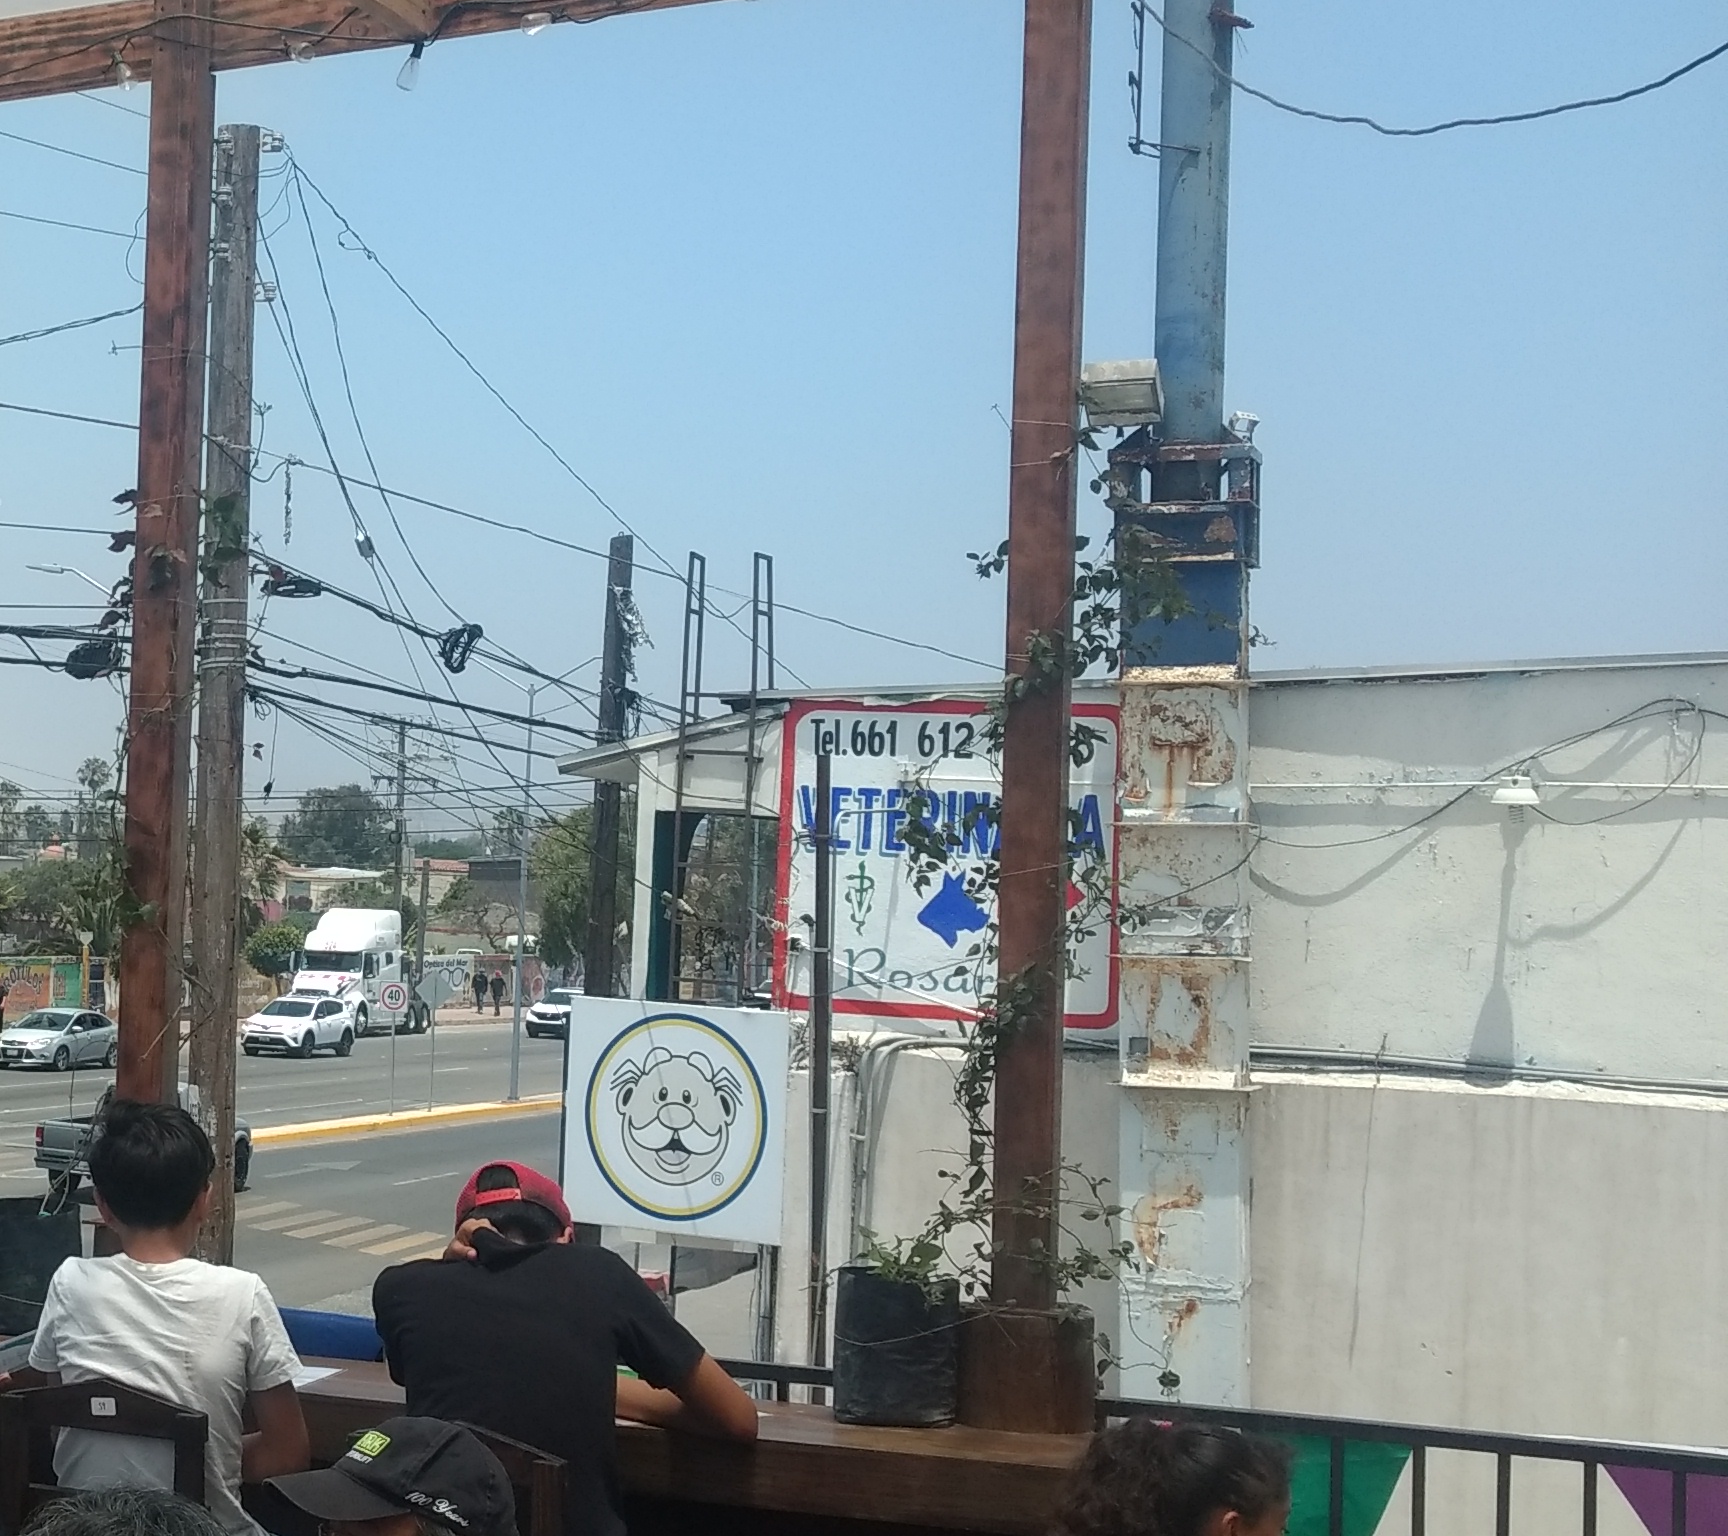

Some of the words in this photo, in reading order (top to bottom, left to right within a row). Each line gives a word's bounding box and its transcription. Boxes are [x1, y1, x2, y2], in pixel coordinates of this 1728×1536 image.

[917, 721, 975, 759] 612
[799, 784, 1105, 859] VETERINA
[387, 989, 401, 1002] 40
[405, 1491, 433, 1506] 100
[432, 1498, 470, 1527] Years
